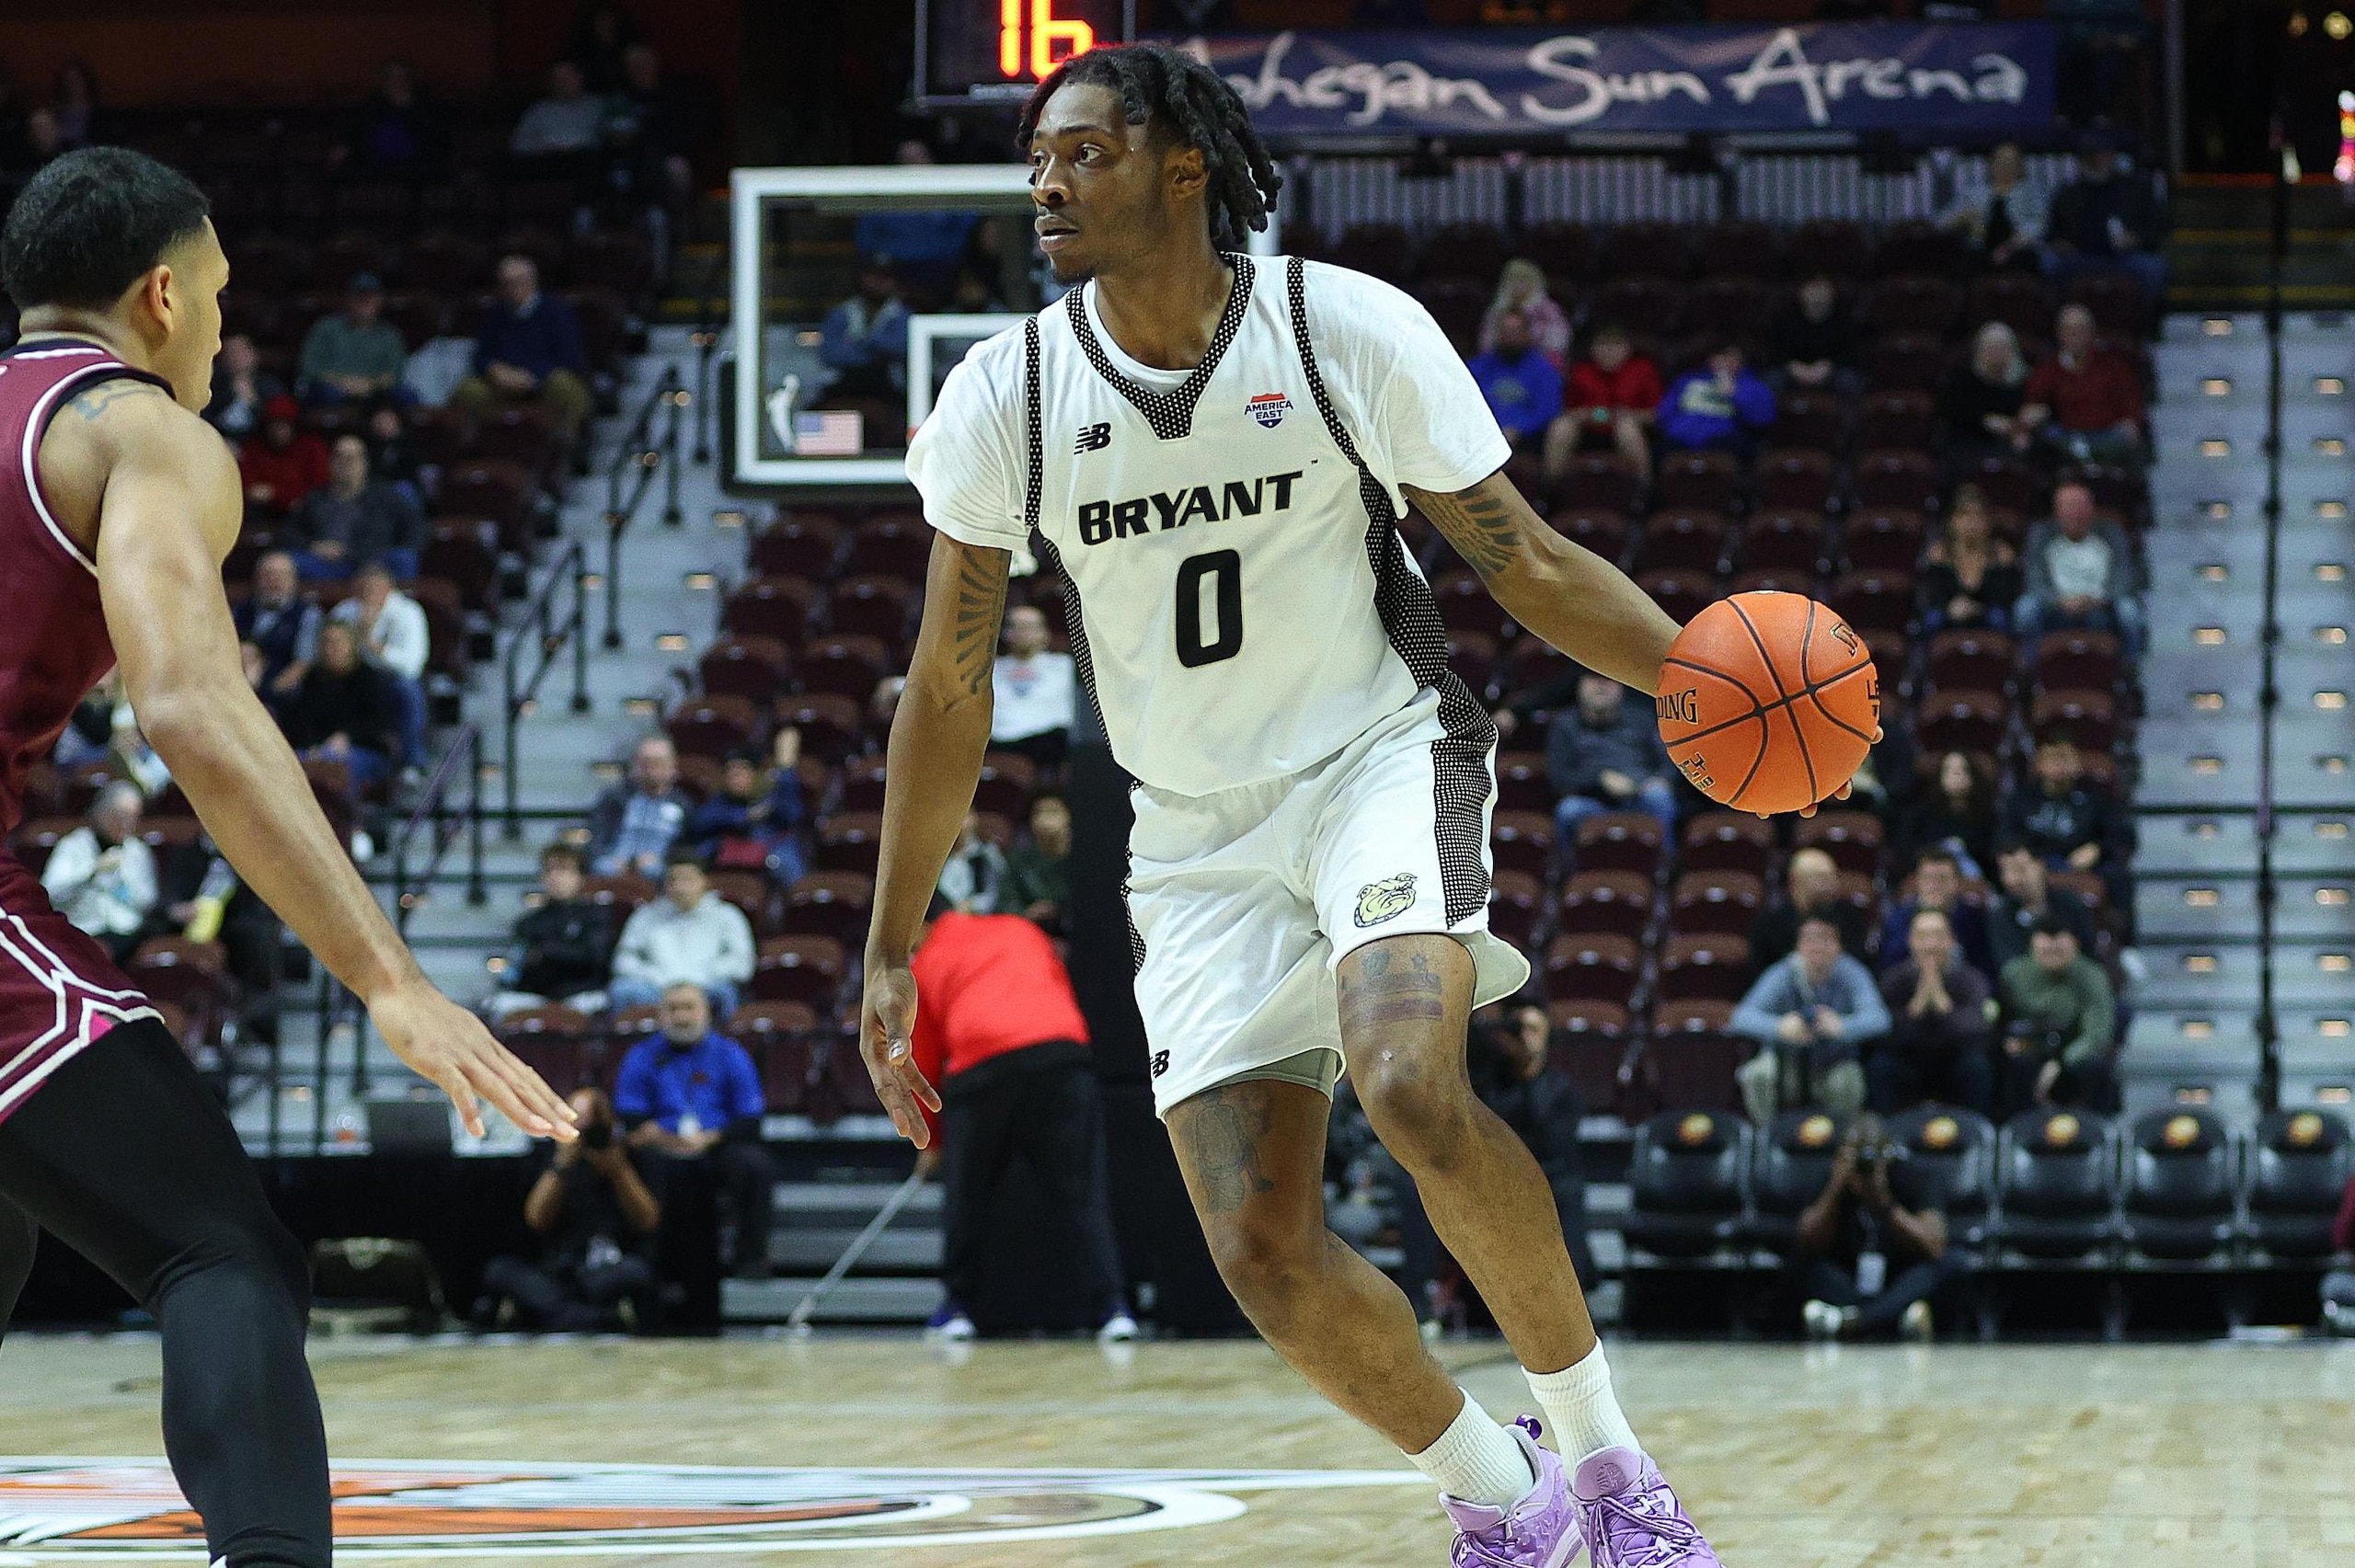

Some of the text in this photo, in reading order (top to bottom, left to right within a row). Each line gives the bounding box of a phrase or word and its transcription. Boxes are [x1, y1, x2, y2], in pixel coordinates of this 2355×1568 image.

[1179, 29, 2028, 127] ohegan Sun Arena
[1244, 400, 1293, 416] AMERICA
[1256, 410, 1283, 419] EAST
[1078, 471, 1303, 545] BRYANT
[1176, 549, 1243, 668] 0
